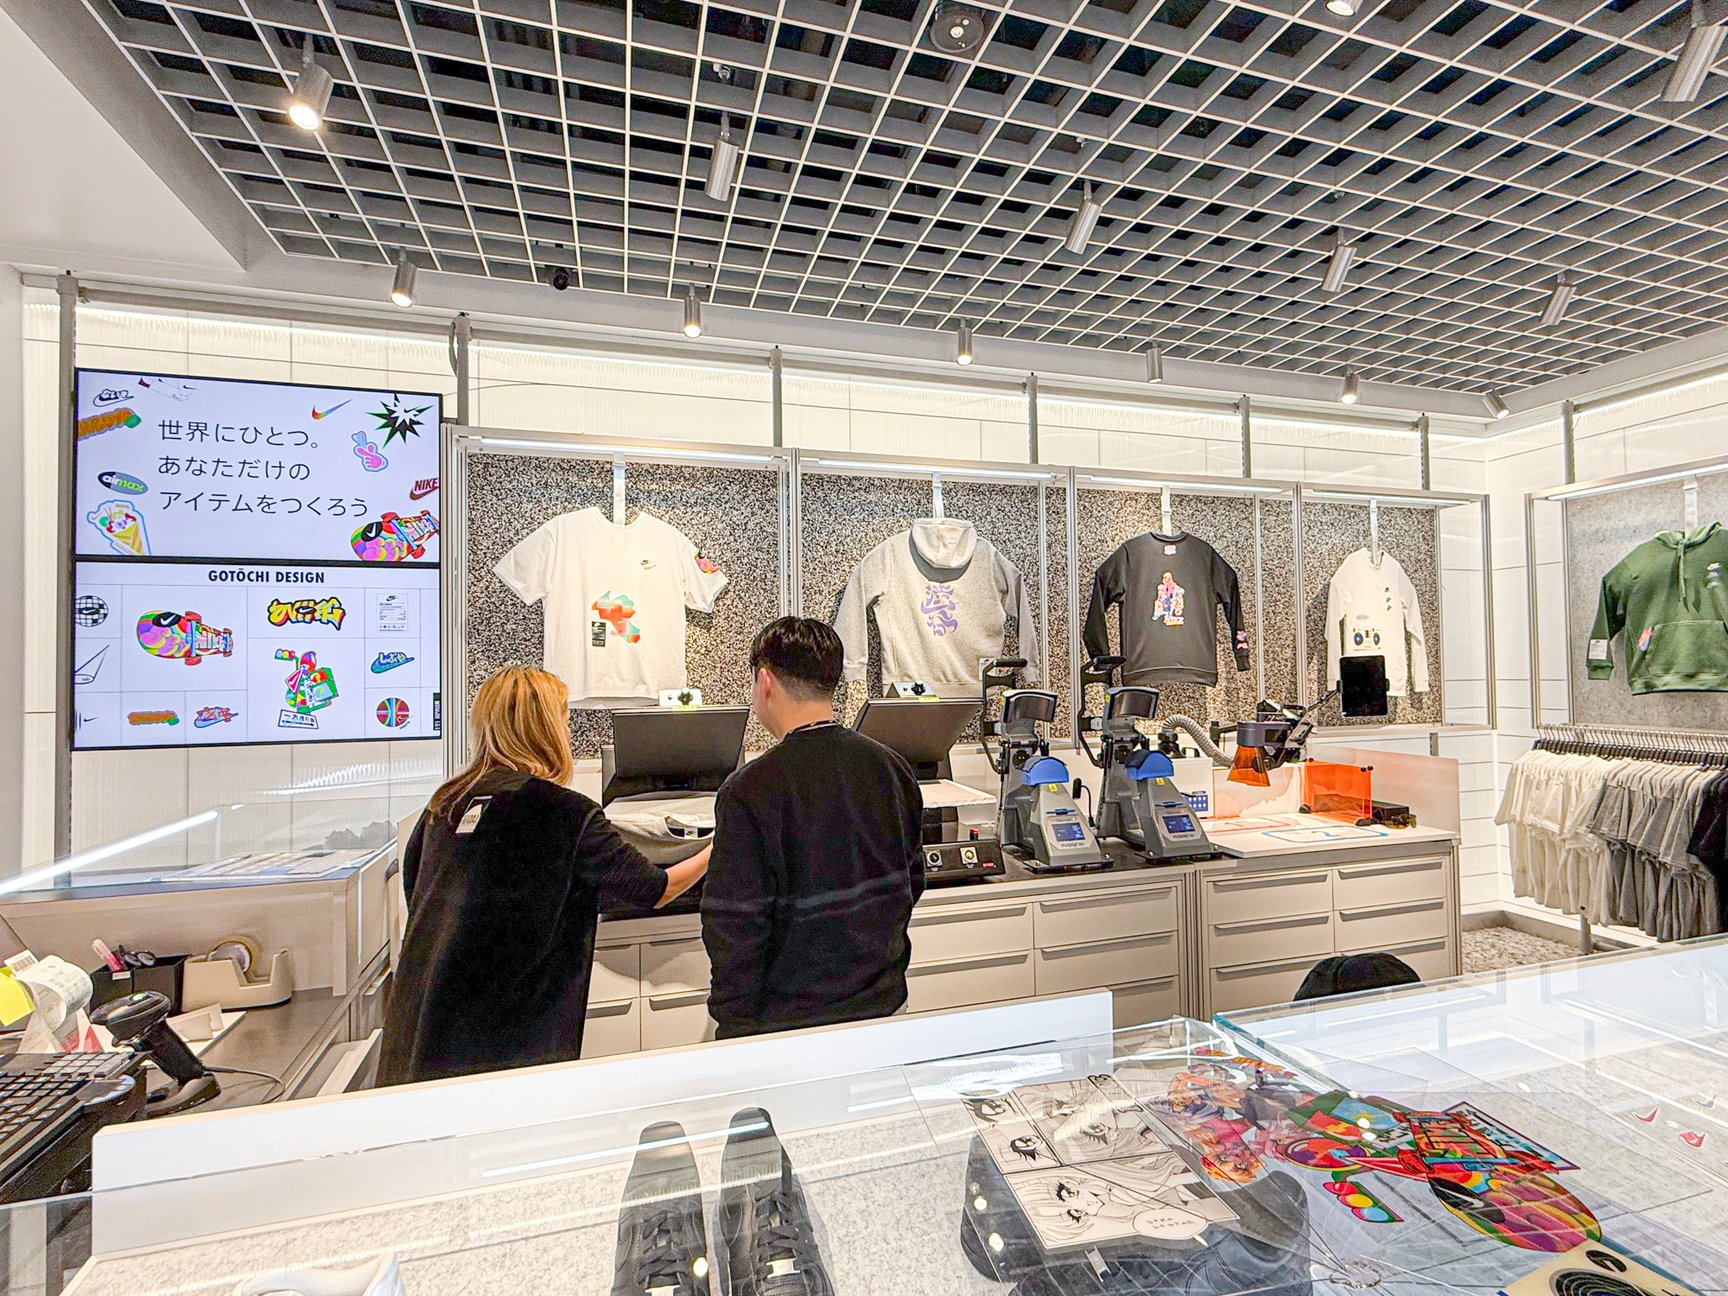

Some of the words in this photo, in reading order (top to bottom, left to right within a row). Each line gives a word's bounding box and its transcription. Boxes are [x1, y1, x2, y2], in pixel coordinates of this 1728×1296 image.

[158, 419, 319, 449] 世界にひとつ。
[158, 455, 310, 481] あなただけの
[414, 477, 438, 492] NIKE
[160, 491, 368, 517] アイテムをつくろう
[208, 568, 270, 583] GOTŌCHI
[275, 571, 325, 584] DESIGN
